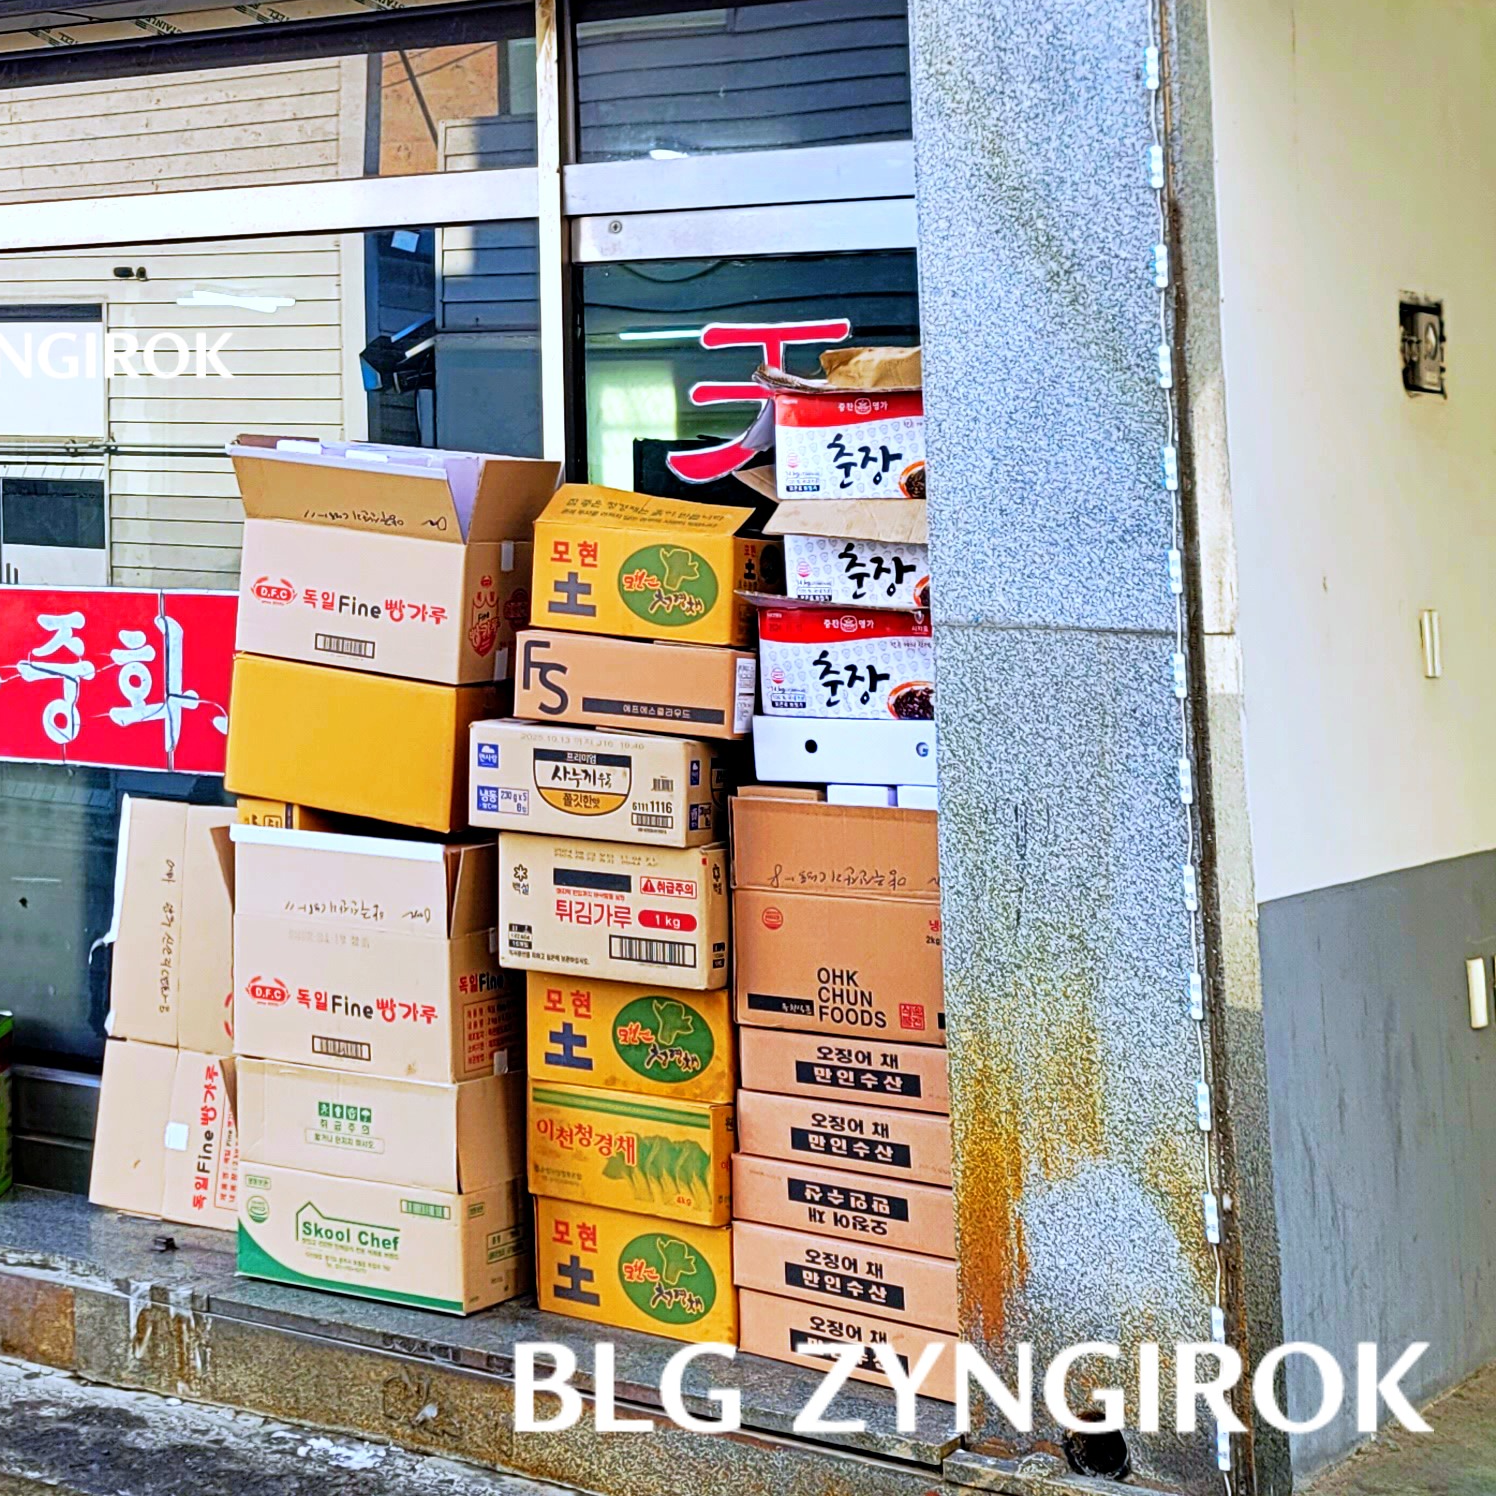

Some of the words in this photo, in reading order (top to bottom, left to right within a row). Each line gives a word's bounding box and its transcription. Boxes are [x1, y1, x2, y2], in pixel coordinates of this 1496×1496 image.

[826, 433, 903, 489] 춘장
[550, 540, 599, 568] 모현
[838, 542, 916, 599] 춘장
[338, 595, 382, 620] Fine
[812, 650, 891, 708] 춘장
[656, 880, 694, 896] 취급주의
[555, 899, 633, 930] 튀김가루
[665, 915, 681, 929] kg
[817, 967, 859, 987] OHK
[331, 994, 374, 1020] Fine
[544, 988, 592, 1019] 모현
[817, 986, 872, 1008] CHUN
[818, 1005, 887, 1029] FOODS
[816, 1045, 872, 1067] 오징어
[880, 1052, 899, 1069] 채
[813, 1067, 904, 1092] 만인수산
[811, 1112, 865, 1135] 오징어
[871, 1120, 890, 1139] 채
[196, 1128, 215, 1175] Fine
[536, 1118, 637, 1165] 이천청경채
[808, 1133, 894, 1162] 만인수산
[804, 1183, 891, 1215] 만인수산
[552, 1218, 598, 1254] 모현
[833, 1207, 888, 1236] 오징어
[302, 1221, 350, 1244] Skool
[358, 1230, 400, 1252] Chef
[805, 1248, 859, 1274] 오징어
[865, 1261, 884, 1279] 채
[802, 1270, 888, 1303] 만인수산
[809, 1315, 863, 1343] 오징어
